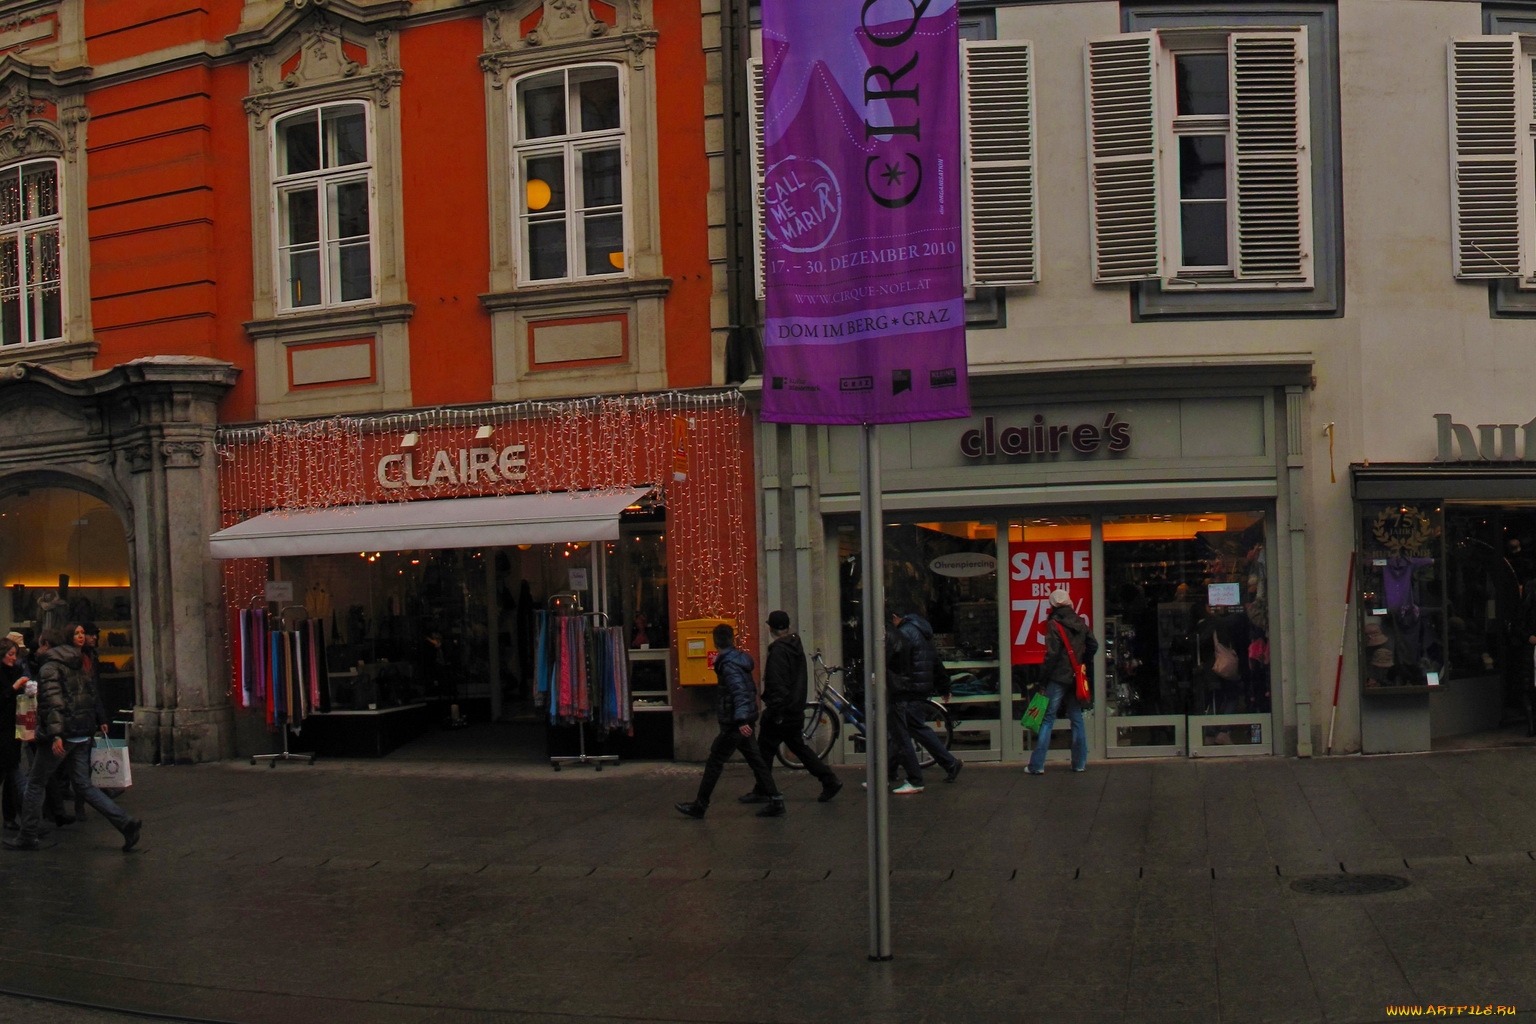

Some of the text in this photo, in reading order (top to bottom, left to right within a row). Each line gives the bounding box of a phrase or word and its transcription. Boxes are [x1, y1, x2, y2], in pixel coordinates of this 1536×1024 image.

[764, 171, 806, 205] CALL
[770, 198, 797, 225] ME
[806, 261, 827, 275] 30.
[830, 245, 920, 272] DEZEMBER
[922, 241, 956, 257] 2010
[778, 308, 951, 339] DOM IM BERG GRAZ
[960, 412, 1131, 458] claire's
[377, 444, 526, 488] CLAIRE
[1390, 513, 1414, 528] 75
[934, 559, 995, 570] Ohrenpiercing
[1010, 550, 1091, 581] SALE
[1031, 582, 1051, 597] BIS
